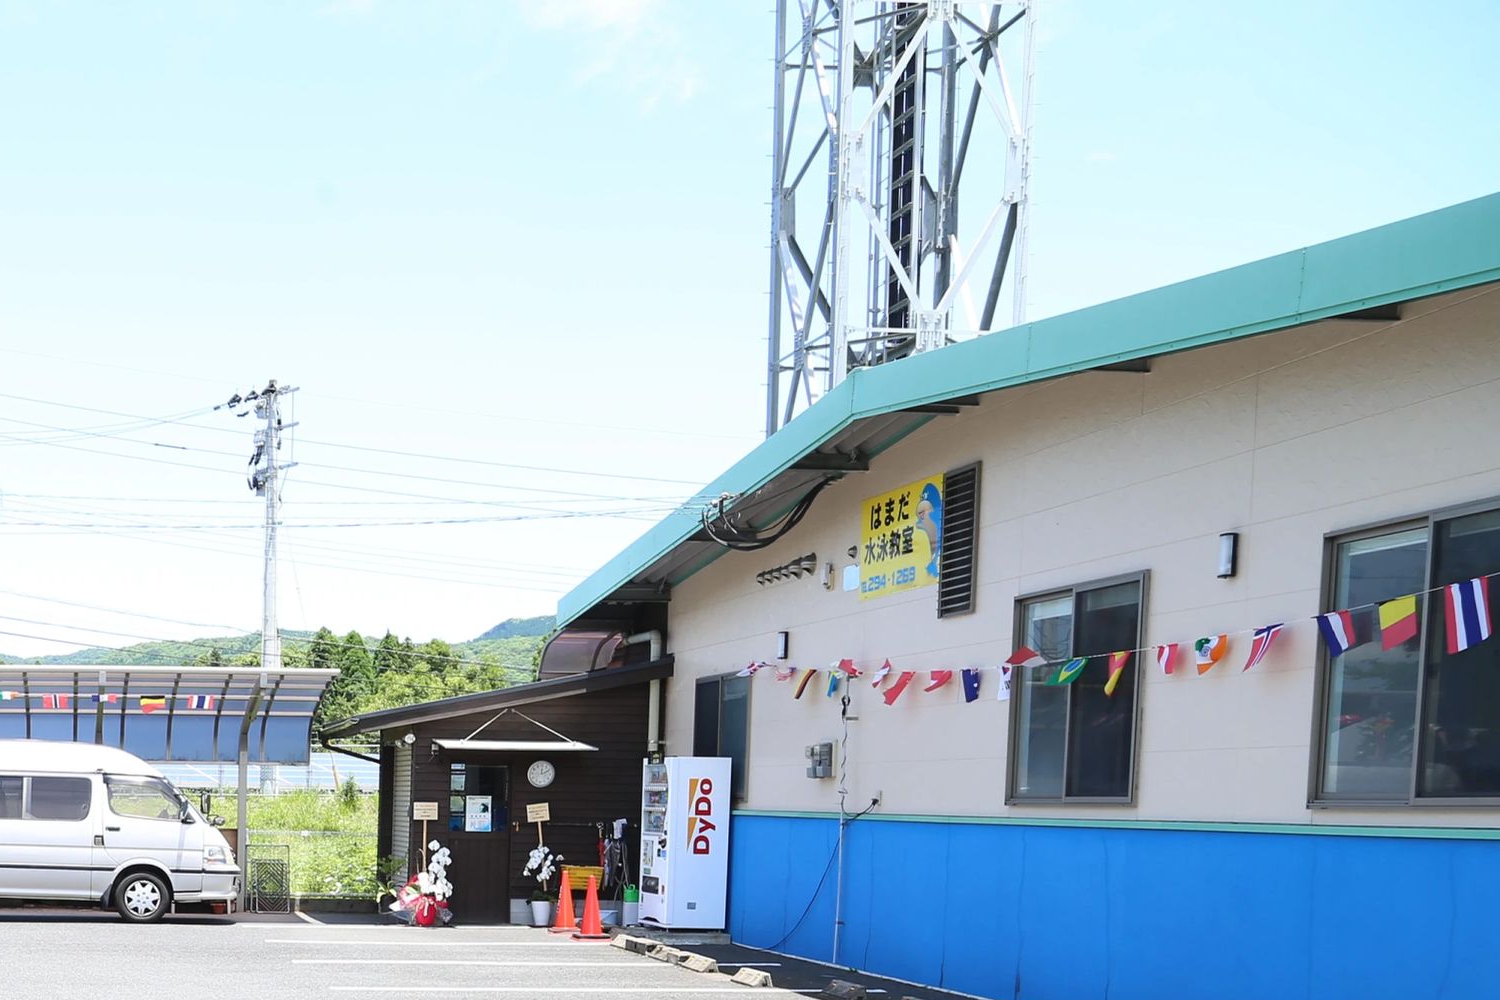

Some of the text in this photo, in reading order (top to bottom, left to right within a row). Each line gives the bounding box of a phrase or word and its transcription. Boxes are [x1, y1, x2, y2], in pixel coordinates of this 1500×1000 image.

[870, 490, 912, 531] はまだ
[864, 526, 914, 565] 水泳教室
[693, 778, 717, 855] DyDo
